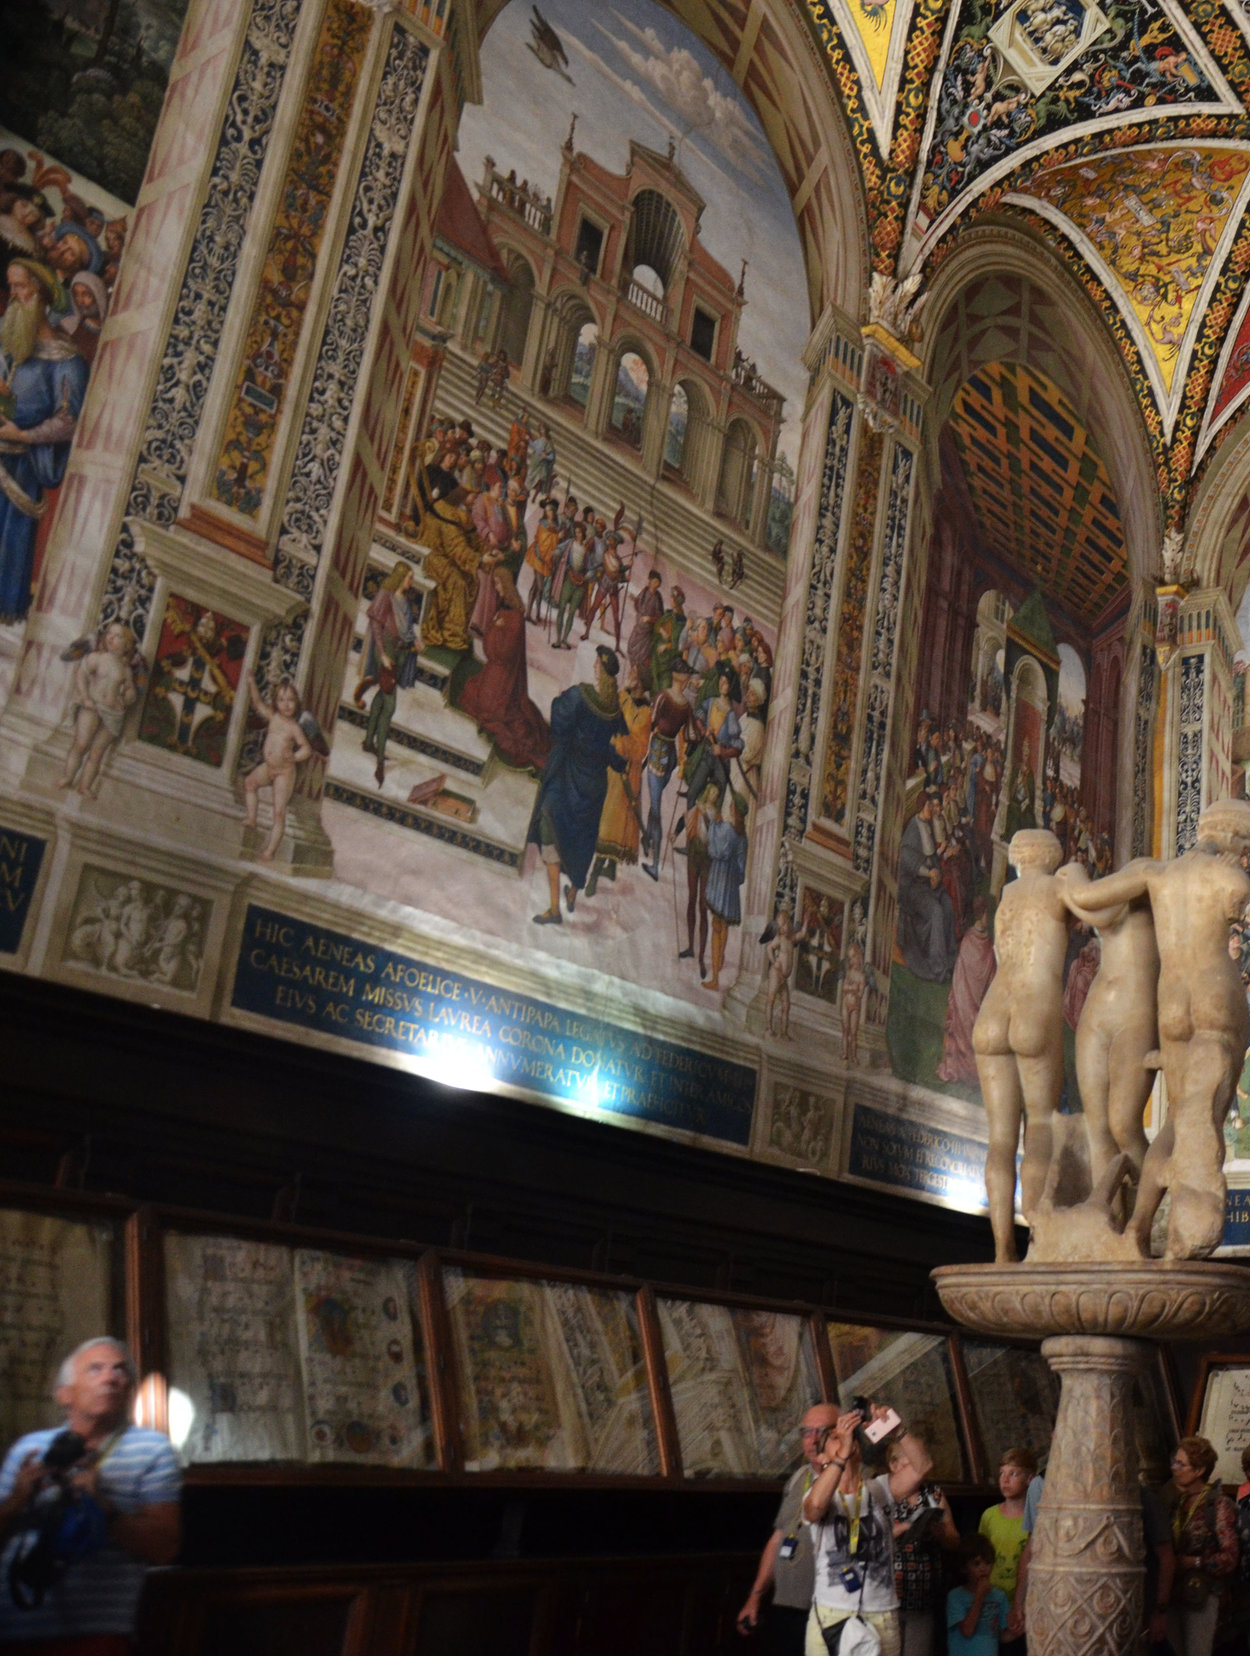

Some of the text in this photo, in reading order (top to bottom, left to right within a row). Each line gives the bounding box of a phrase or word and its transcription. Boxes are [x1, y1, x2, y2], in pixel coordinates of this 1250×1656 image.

[250, 949, 356, 997] CAESAREM
[362, 982, 424, 1017] MISSVS
[428, 1002, 492, 1038] LAVREA
[499, 1025, 566, 1060] CORONA
[255, 918, 295, 947] HIC
[302, 936, 376, 973] AENEAS
[486, 995, 561, 1032] ANTIPAPA
[275, 986, 317, 1014] EIVS
[322, 1001, 350, 1023] AC
